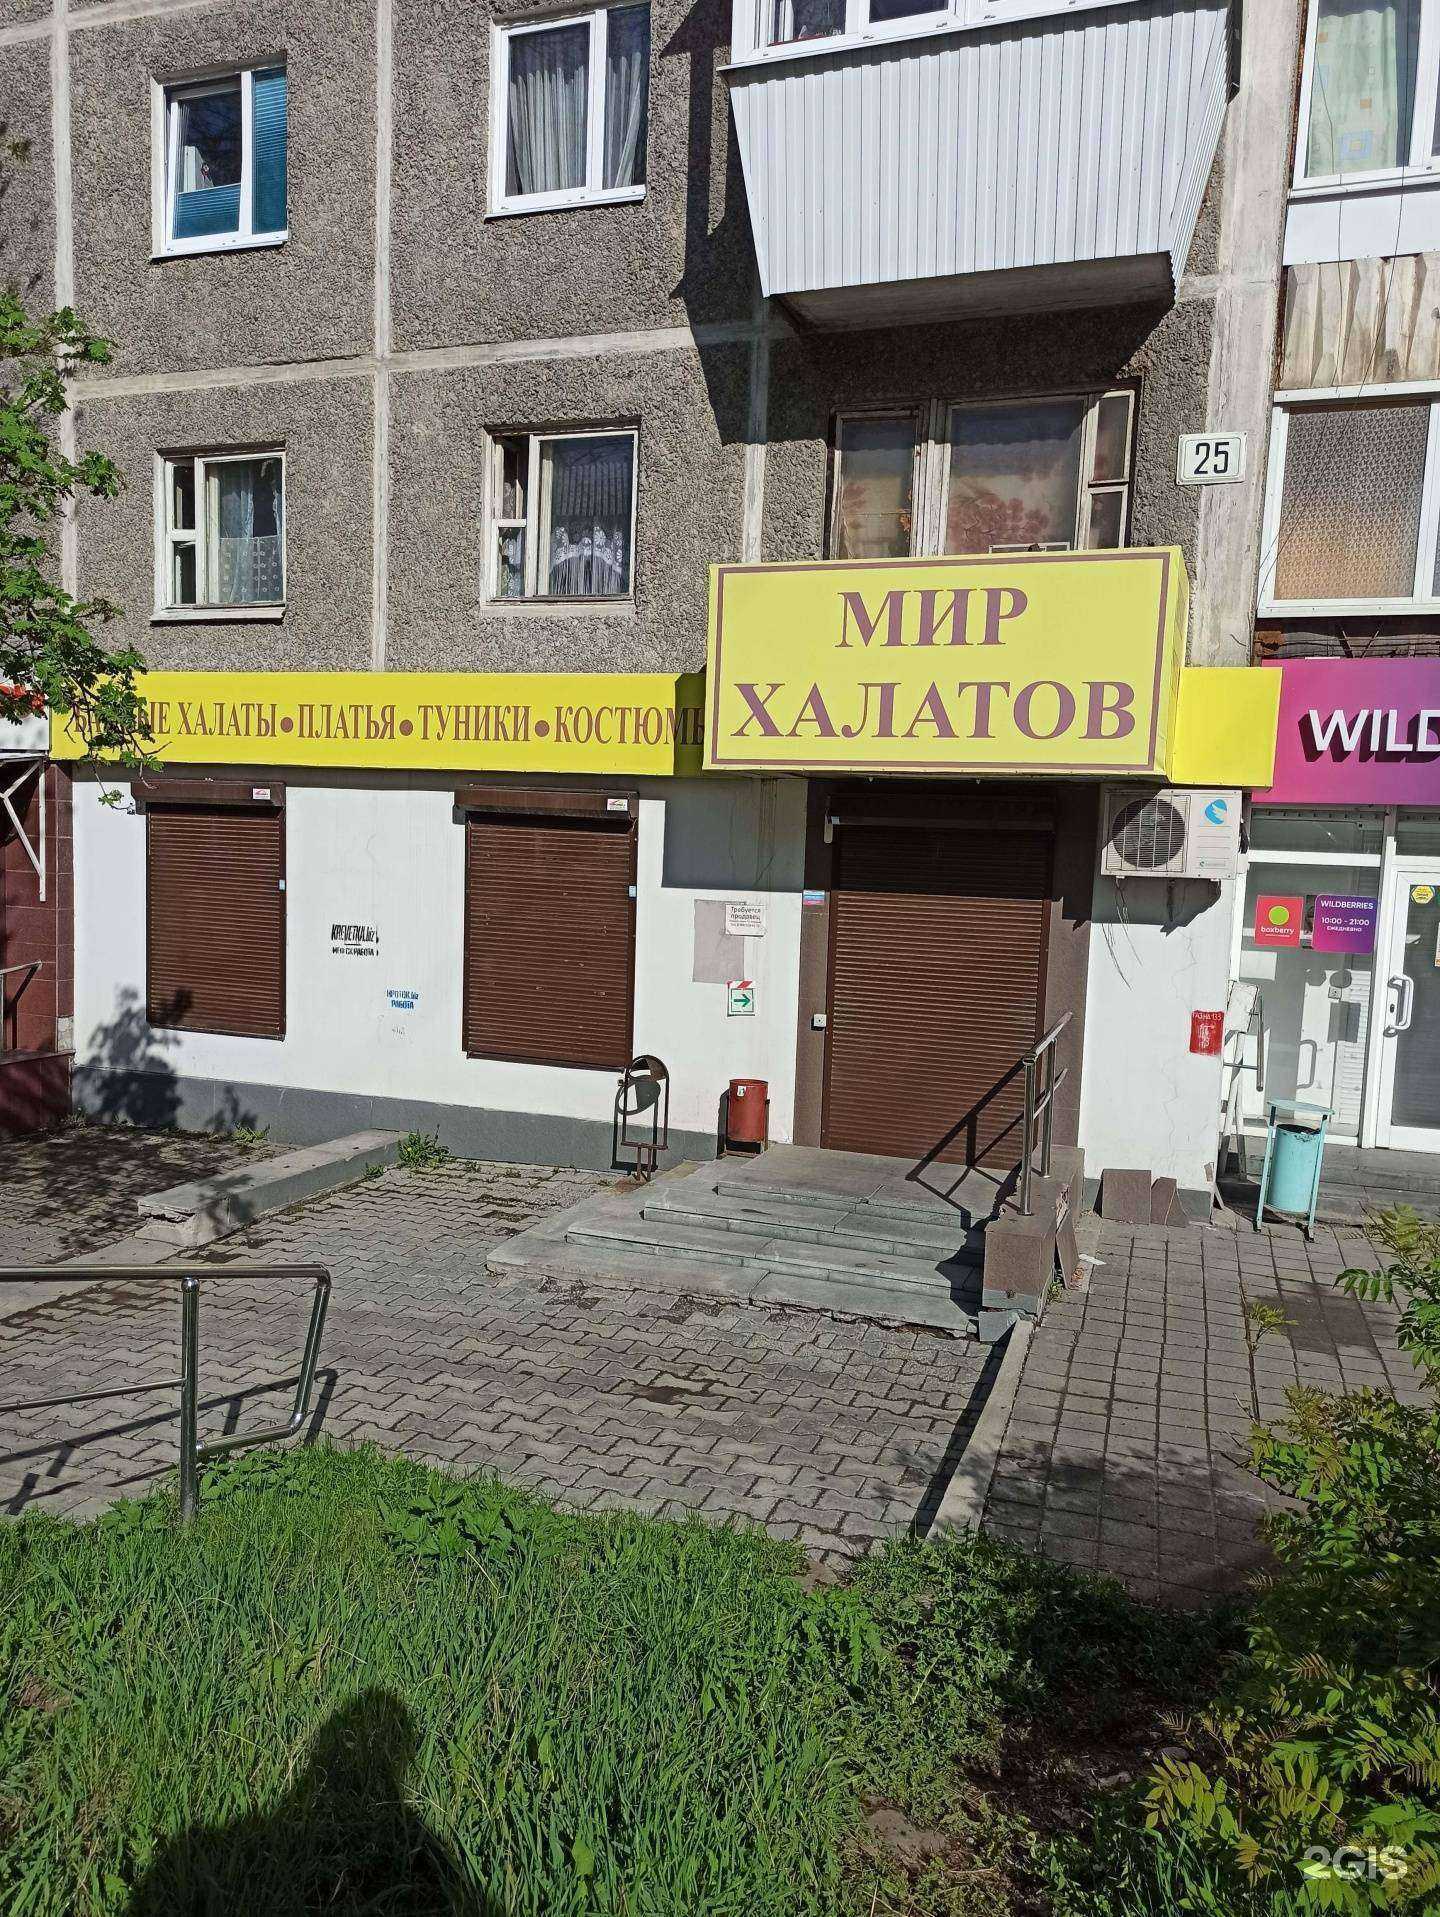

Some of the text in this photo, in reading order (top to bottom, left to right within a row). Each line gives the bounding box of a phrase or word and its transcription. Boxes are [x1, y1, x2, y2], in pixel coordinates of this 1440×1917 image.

[1194, 442, 1229, 474] 25
[835, 587, 1028, 647] МИР
[178, 702, 278, 738] ХАЛАТЫ
[297, 704, 396, 740] ПЛАТЬЯ
[418, 705, 531, 742] ТУНИКИ
[730, 680, 1135, 740] ХАЛАТОВ
[1321, 900, 1374, 910] WILDBERRIES
[1260, 926, 1295, 935] boxberry
[1349, 918, 1370, 926] 21:00
